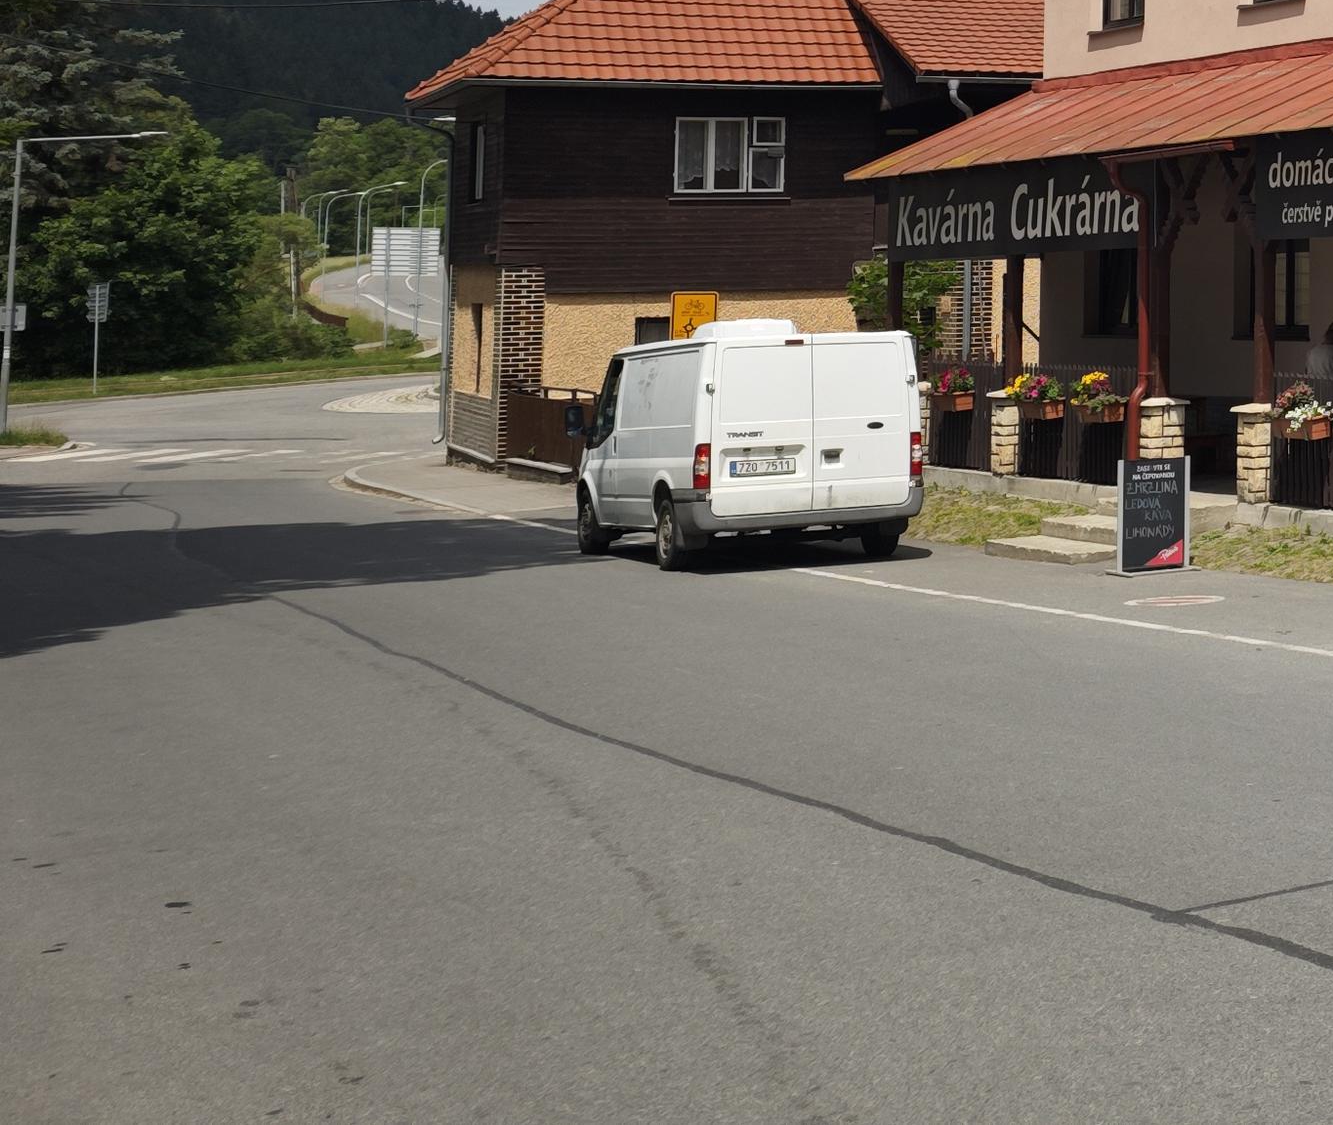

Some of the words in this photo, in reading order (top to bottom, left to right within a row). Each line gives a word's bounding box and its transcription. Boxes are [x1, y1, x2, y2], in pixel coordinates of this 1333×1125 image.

[896, 188, 995, 247] Kavárna
[1010, 174, 1140, 241] Cukrárna
[1281, 200, 1322, 225] čerstvě
[726, 431, 764, 439] TRANSIT
